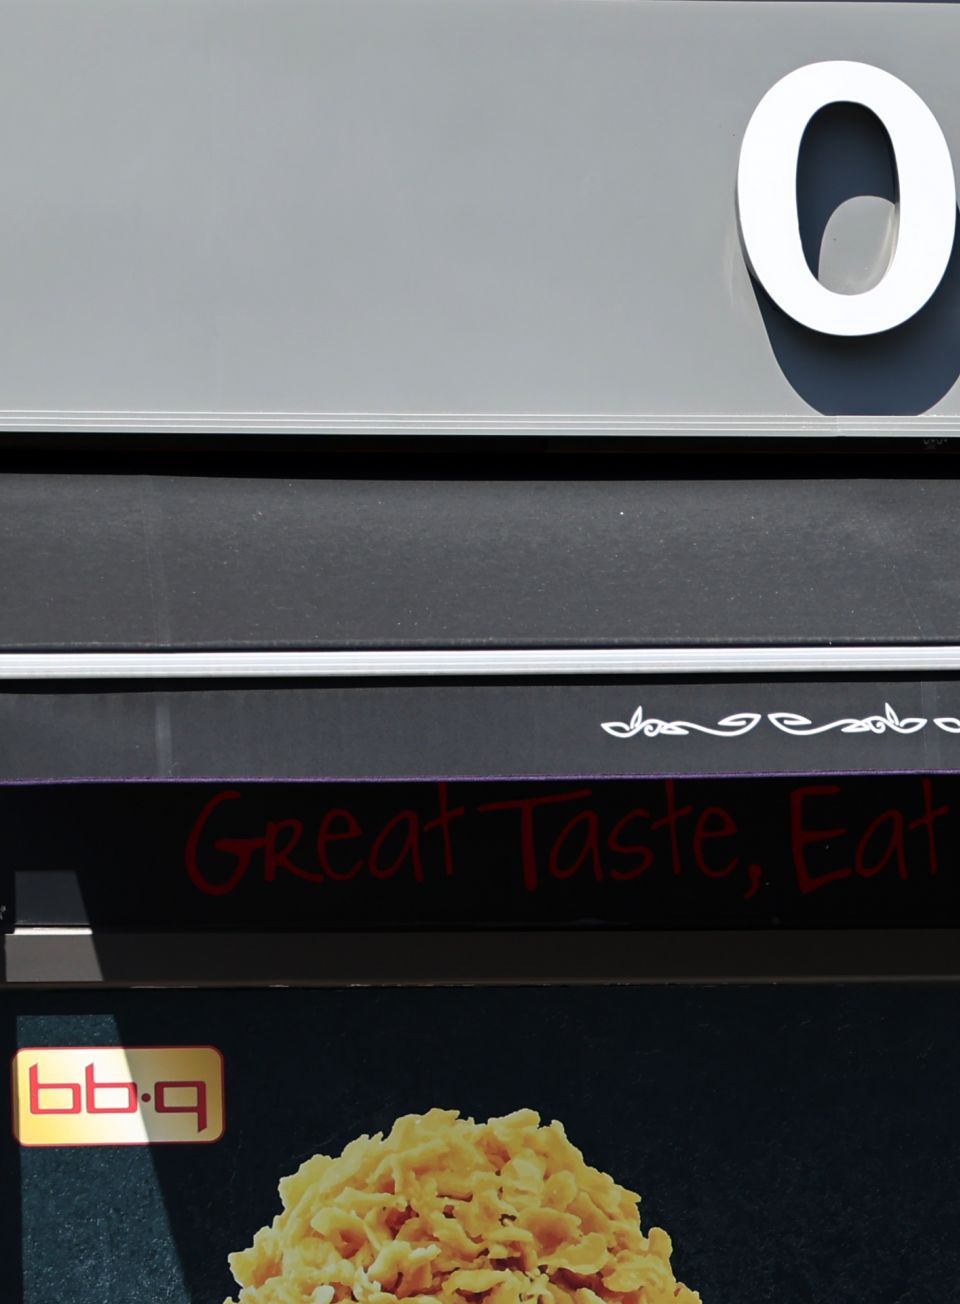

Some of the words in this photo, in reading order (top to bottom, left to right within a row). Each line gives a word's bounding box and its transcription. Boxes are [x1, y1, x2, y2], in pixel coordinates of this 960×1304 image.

[184, 783, 466, 895] Great
[475, 781, 763, 899] Taste,
[788, 777, 952, 896] Eat
